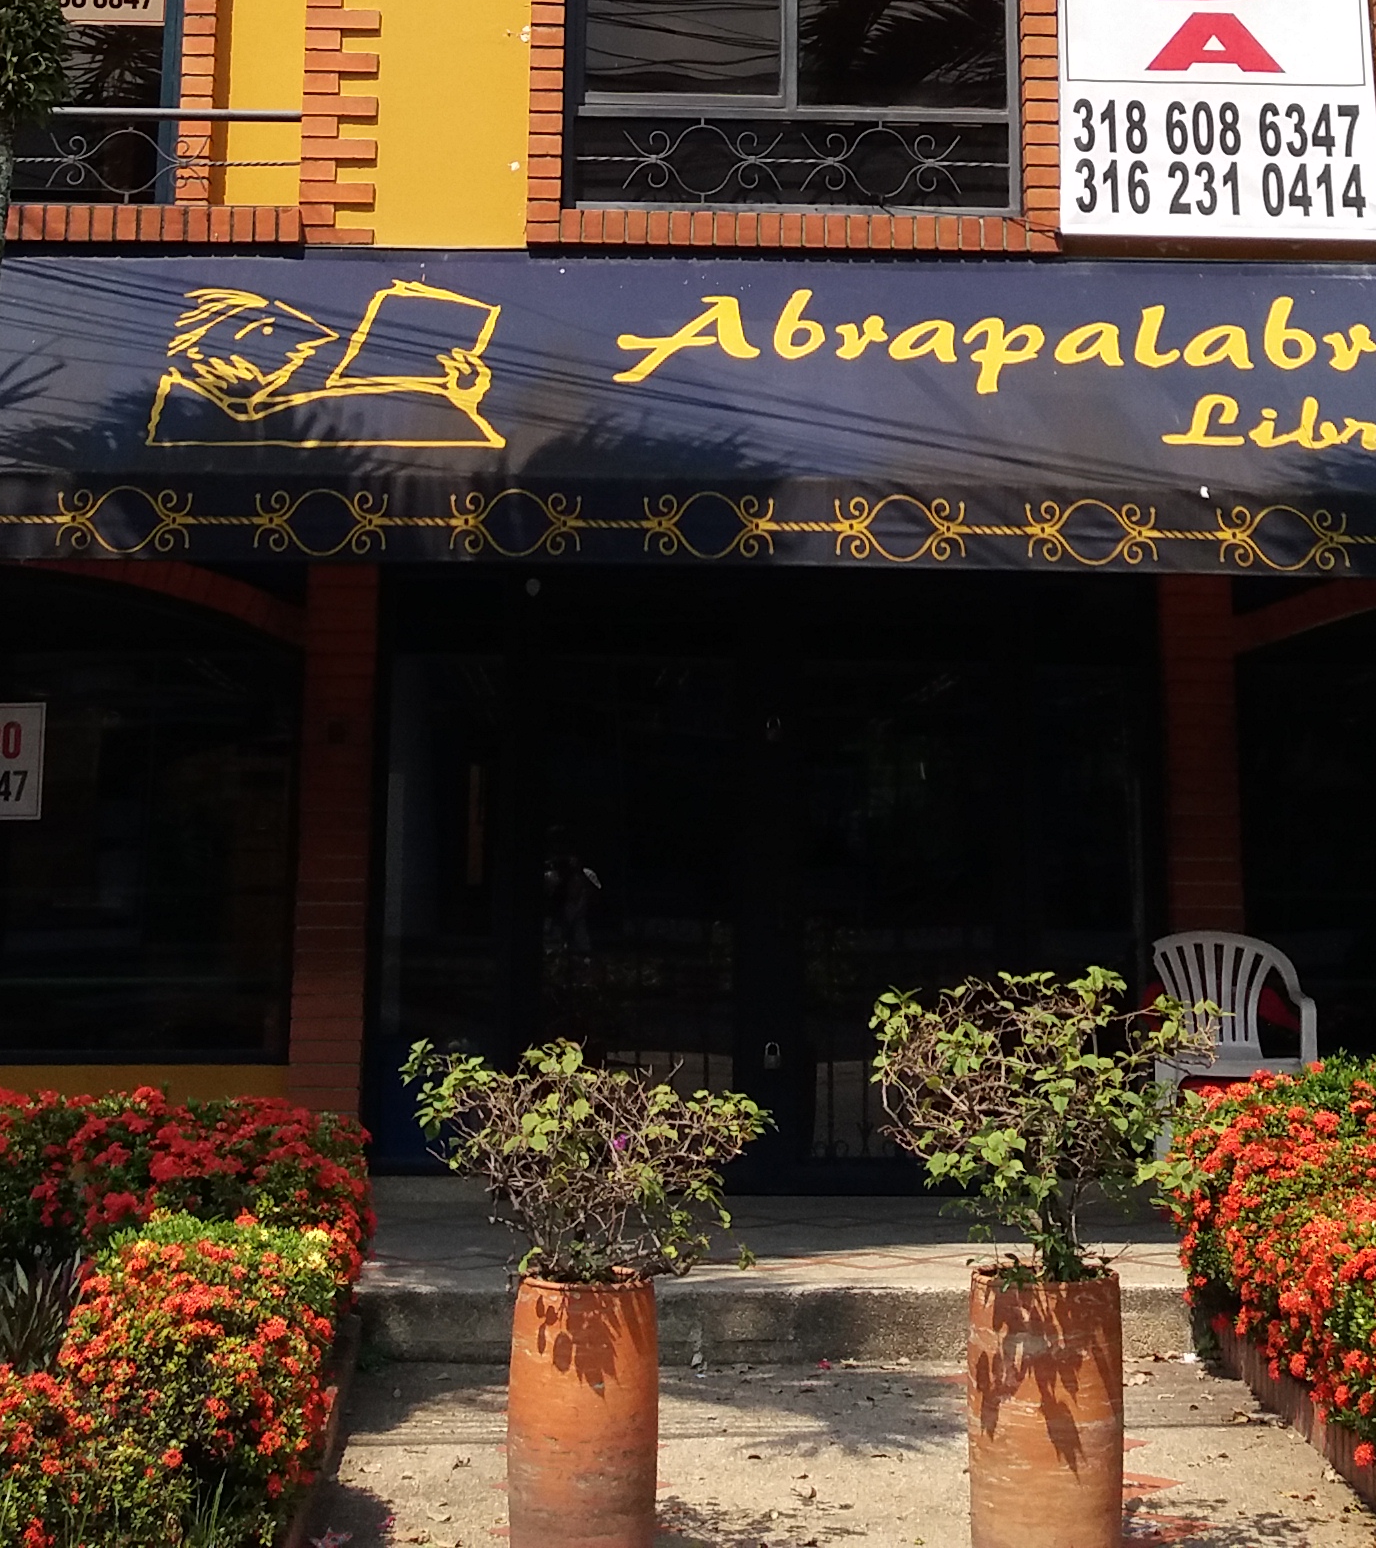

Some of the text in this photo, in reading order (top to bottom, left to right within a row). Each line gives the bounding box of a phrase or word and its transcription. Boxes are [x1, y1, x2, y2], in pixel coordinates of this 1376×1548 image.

[1073, 98, 1360, 157] 318 608 6347
[1075, 158, 1366, 218] 316 231 0414
